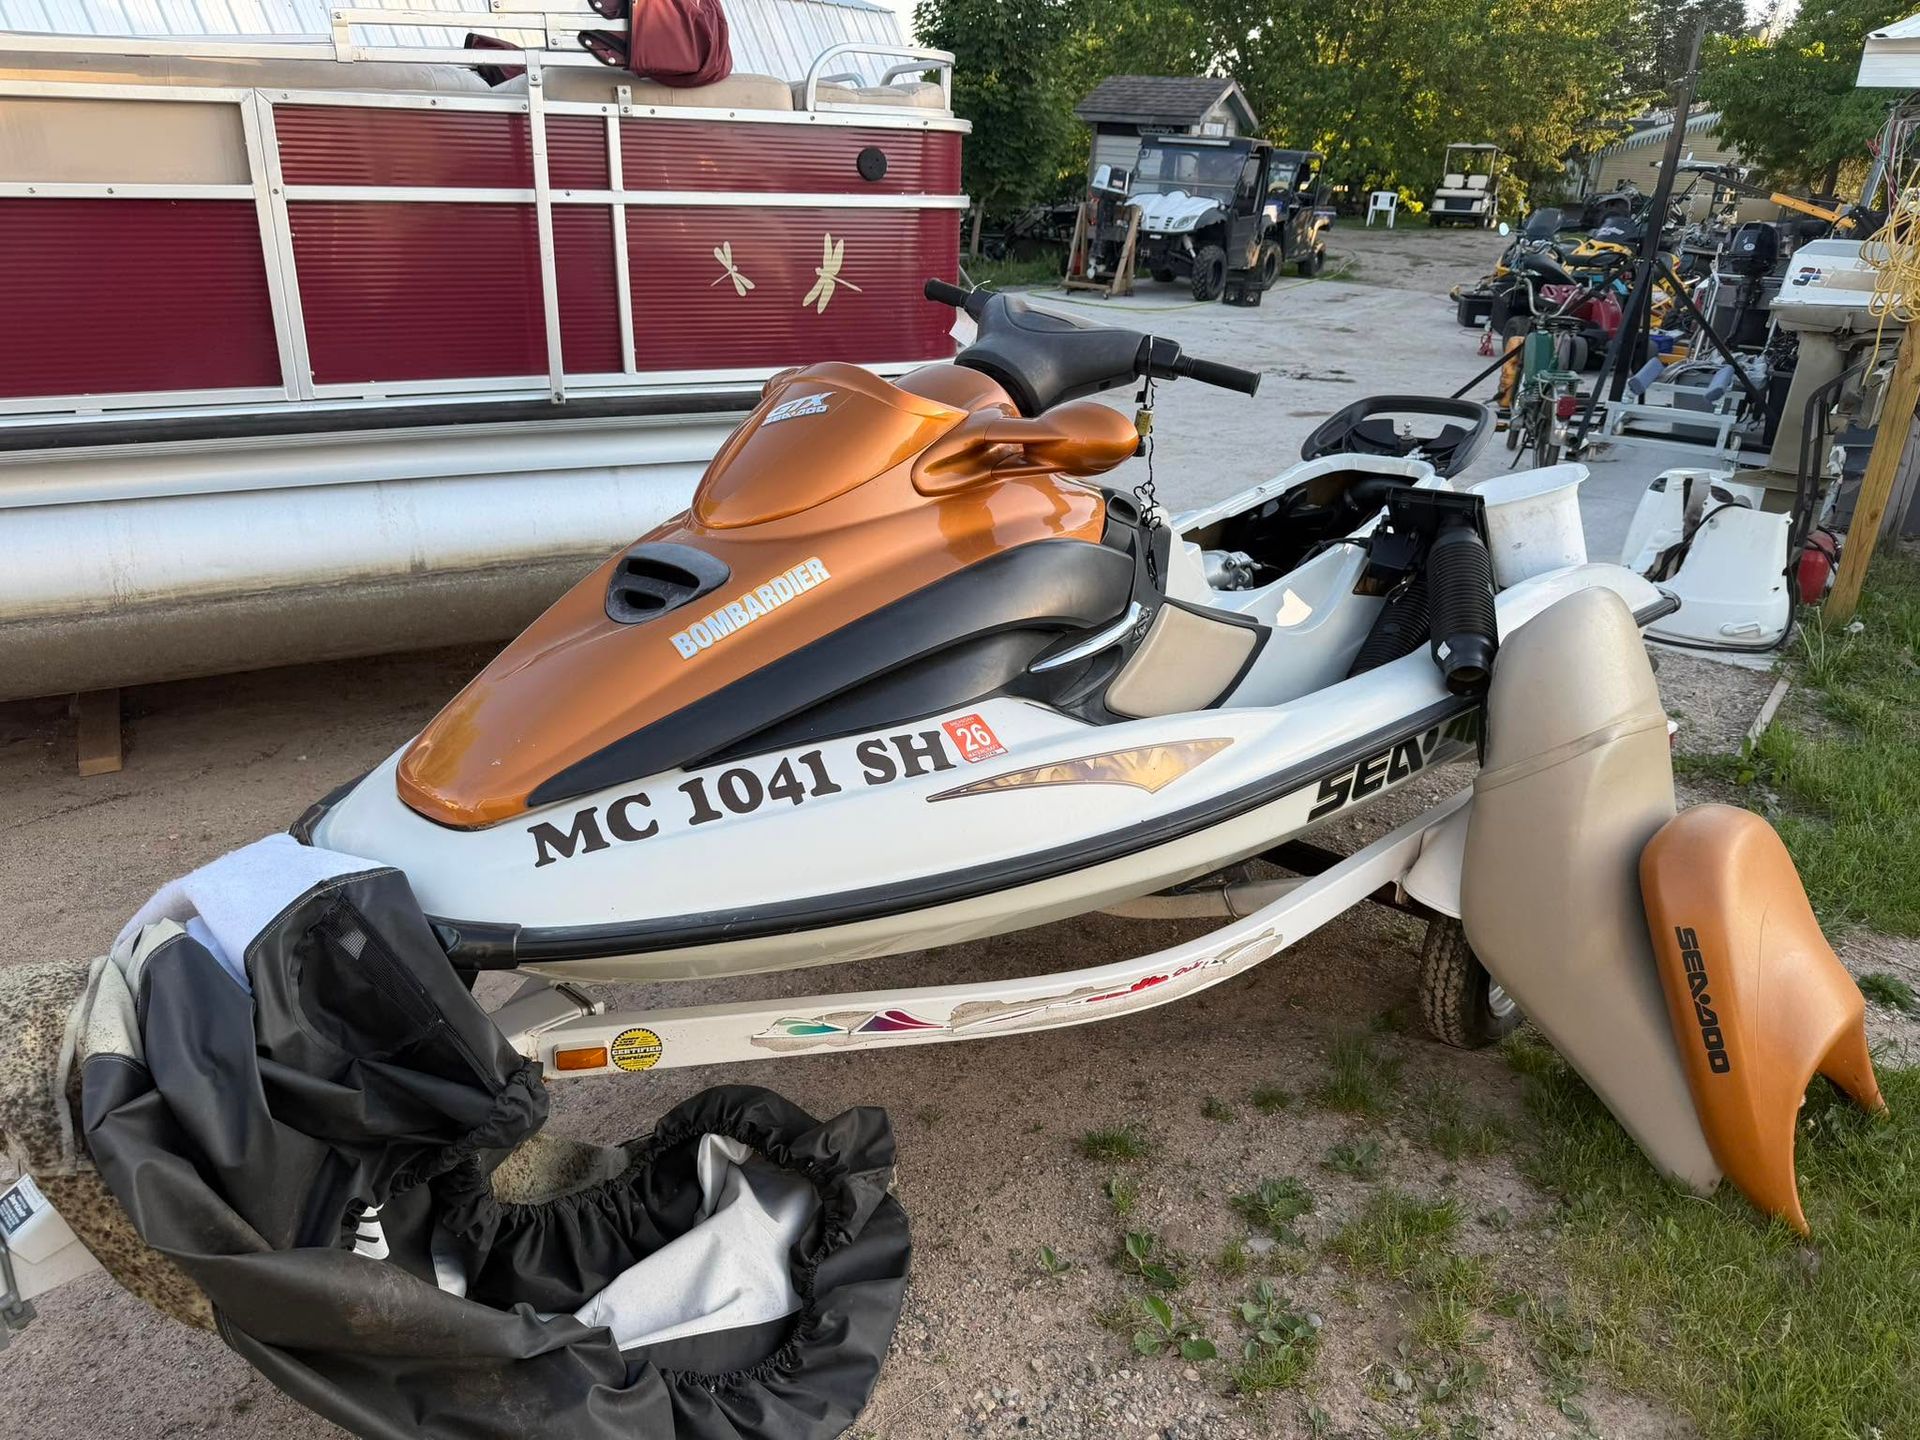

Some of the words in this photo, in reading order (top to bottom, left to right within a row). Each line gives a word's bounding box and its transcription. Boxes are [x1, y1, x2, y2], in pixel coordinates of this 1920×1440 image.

[669, 557, 831, 659] BOMBARDIER
[956, 723, 991, 752] 26
[527, 792, 659, 868] MC
[678, 750, 842, 826] 1041
[856, 730, 957, 786] SH
[611, 1046, 662, 1055] CERTIFIED
